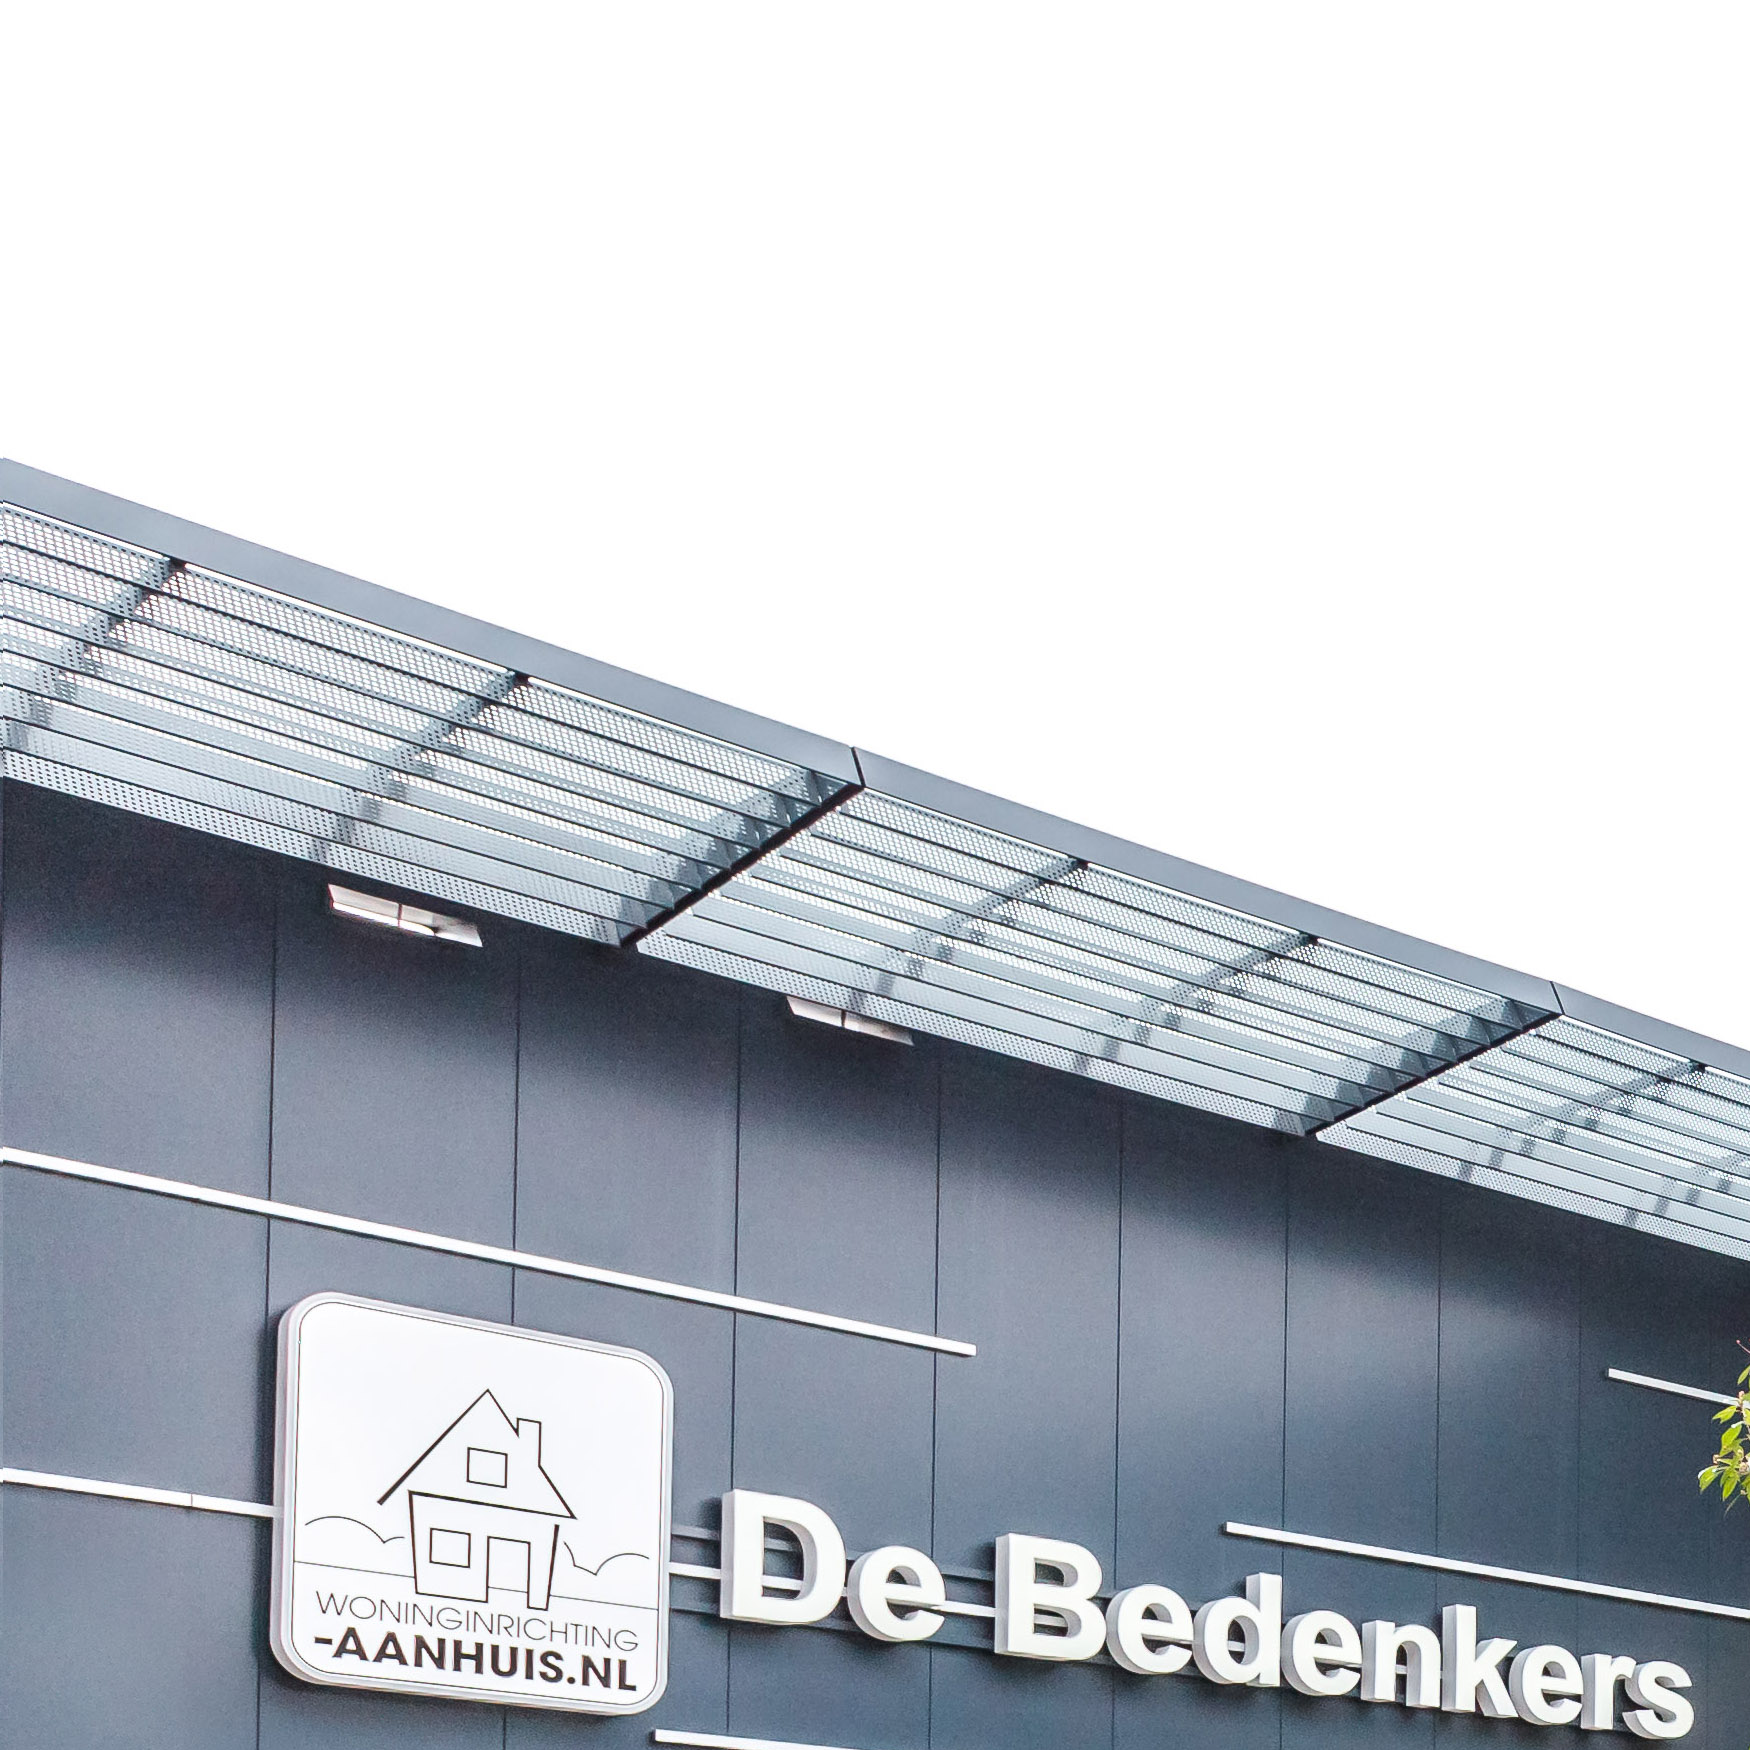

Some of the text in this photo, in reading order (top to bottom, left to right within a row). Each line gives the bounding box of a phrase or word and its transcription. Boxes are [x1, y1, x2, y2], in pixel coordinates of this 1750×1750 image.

[315, 1589, 640, 1653] WONINGINRICHTING
[720, 1488, 1696, 1741] De Bedenkers
[314, 1626, 638, 1693] -AANHUIS.NL
